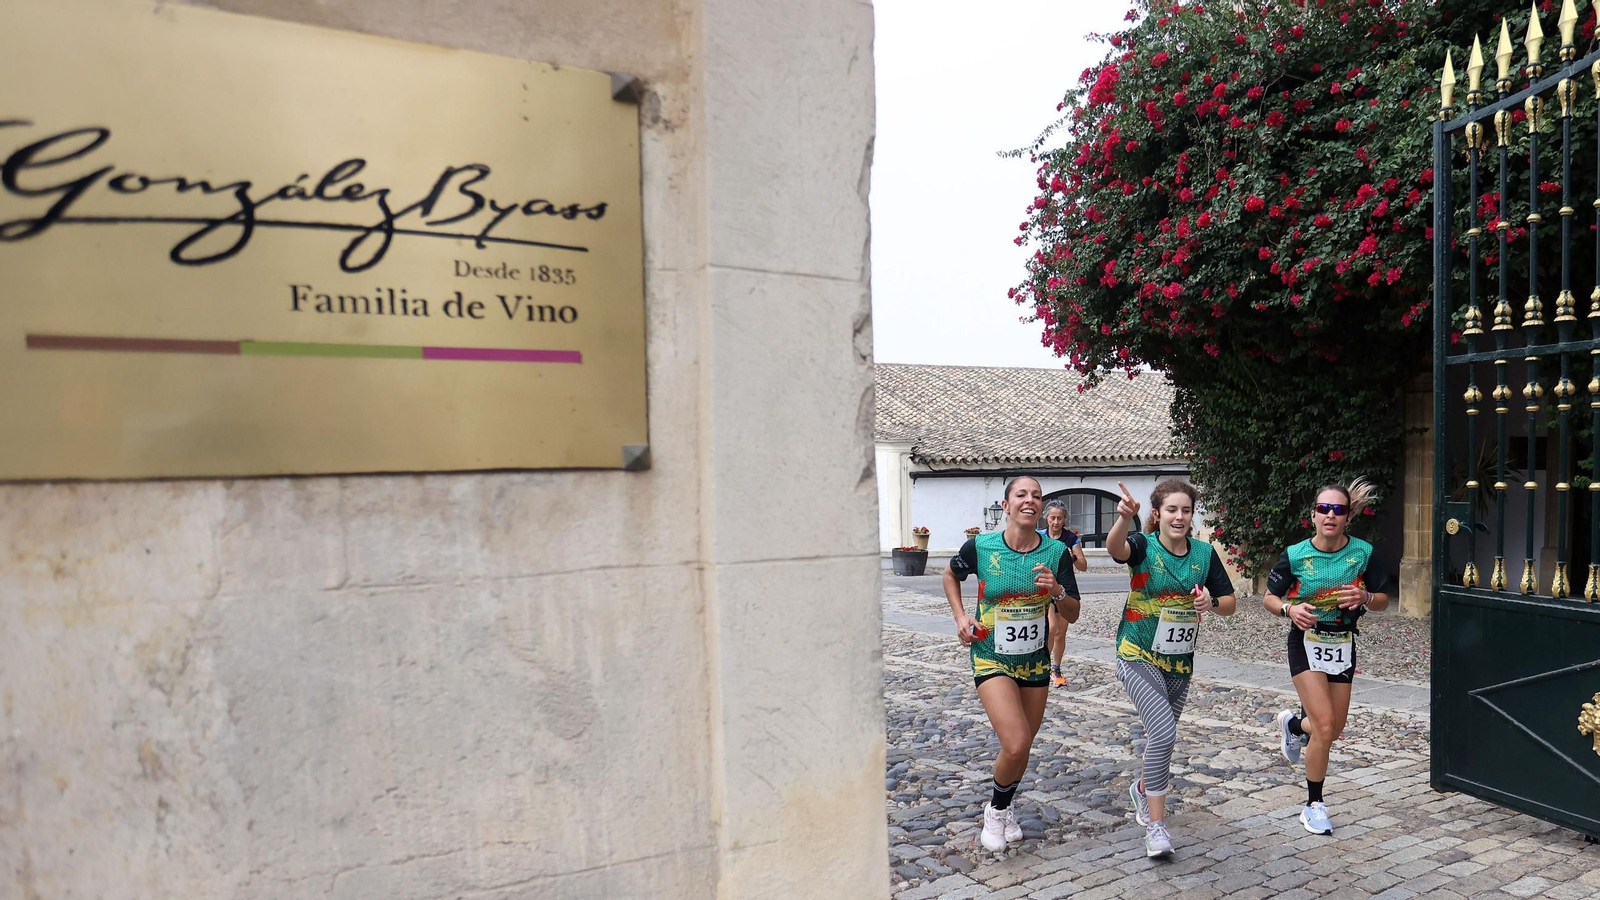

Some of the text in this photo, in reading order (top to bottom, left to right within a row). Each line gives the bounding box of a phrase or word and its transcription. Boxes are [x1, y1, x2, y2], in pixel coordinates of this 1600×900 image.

[0, 126, 609, 273] González Byass
[453, 259, 577, 286] Desde 1835
[288, 284, 579, 324] Familia de Vino
[1005, 624, 1039, 642] 343
[1165, 627, 1195, 643] 138
[1312, 646, 1345, 663] 351
